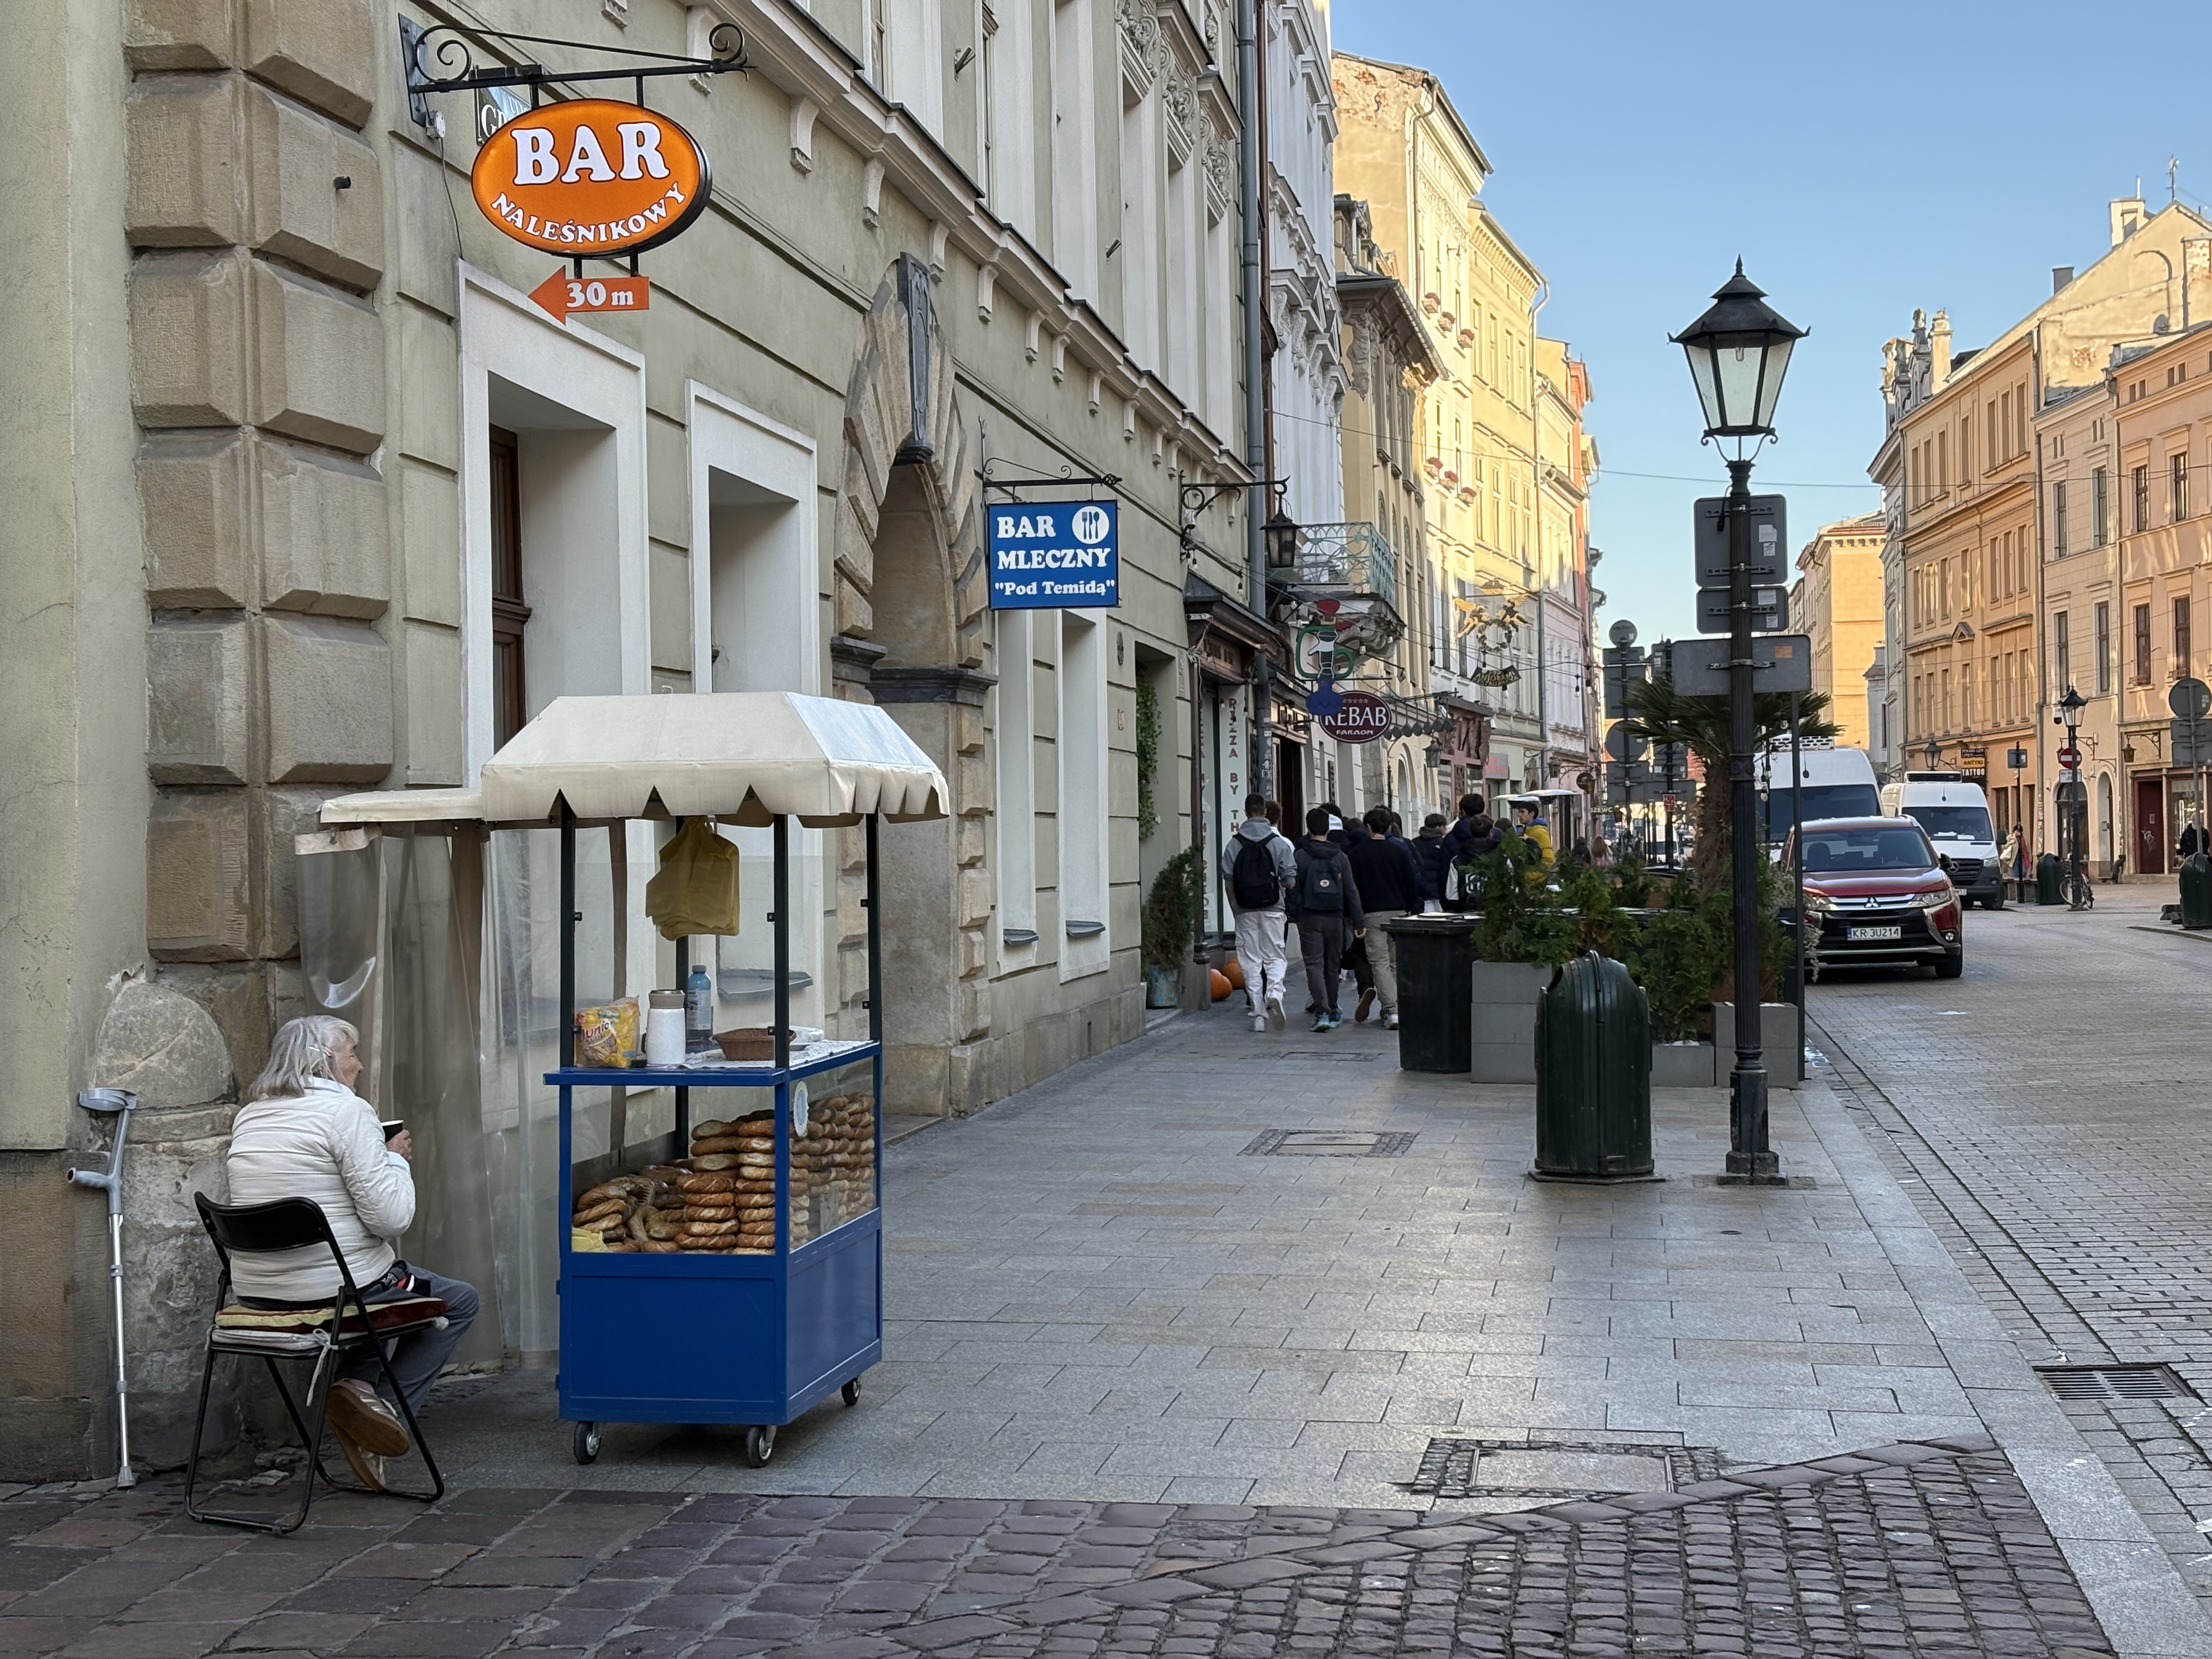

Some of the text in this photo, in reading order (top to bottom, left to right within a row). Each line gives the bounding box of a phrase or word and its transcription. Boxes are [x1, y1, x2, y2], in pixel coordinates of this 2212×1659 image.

[512, 122, 670, 185] BAR
[491, 182, 685, 243] NALEŚNIKOWY
[566, 282, 634, 308] 30 m
[997, 515, 1056, 539] BAR
[997, 547, 1111, 570] MLECZNY
[995, 579, 1115, 597] "Pod Temidą"
[1230, 773, 1239, 795] BY
[1853, 927, 1899, 938] KR 3U214
